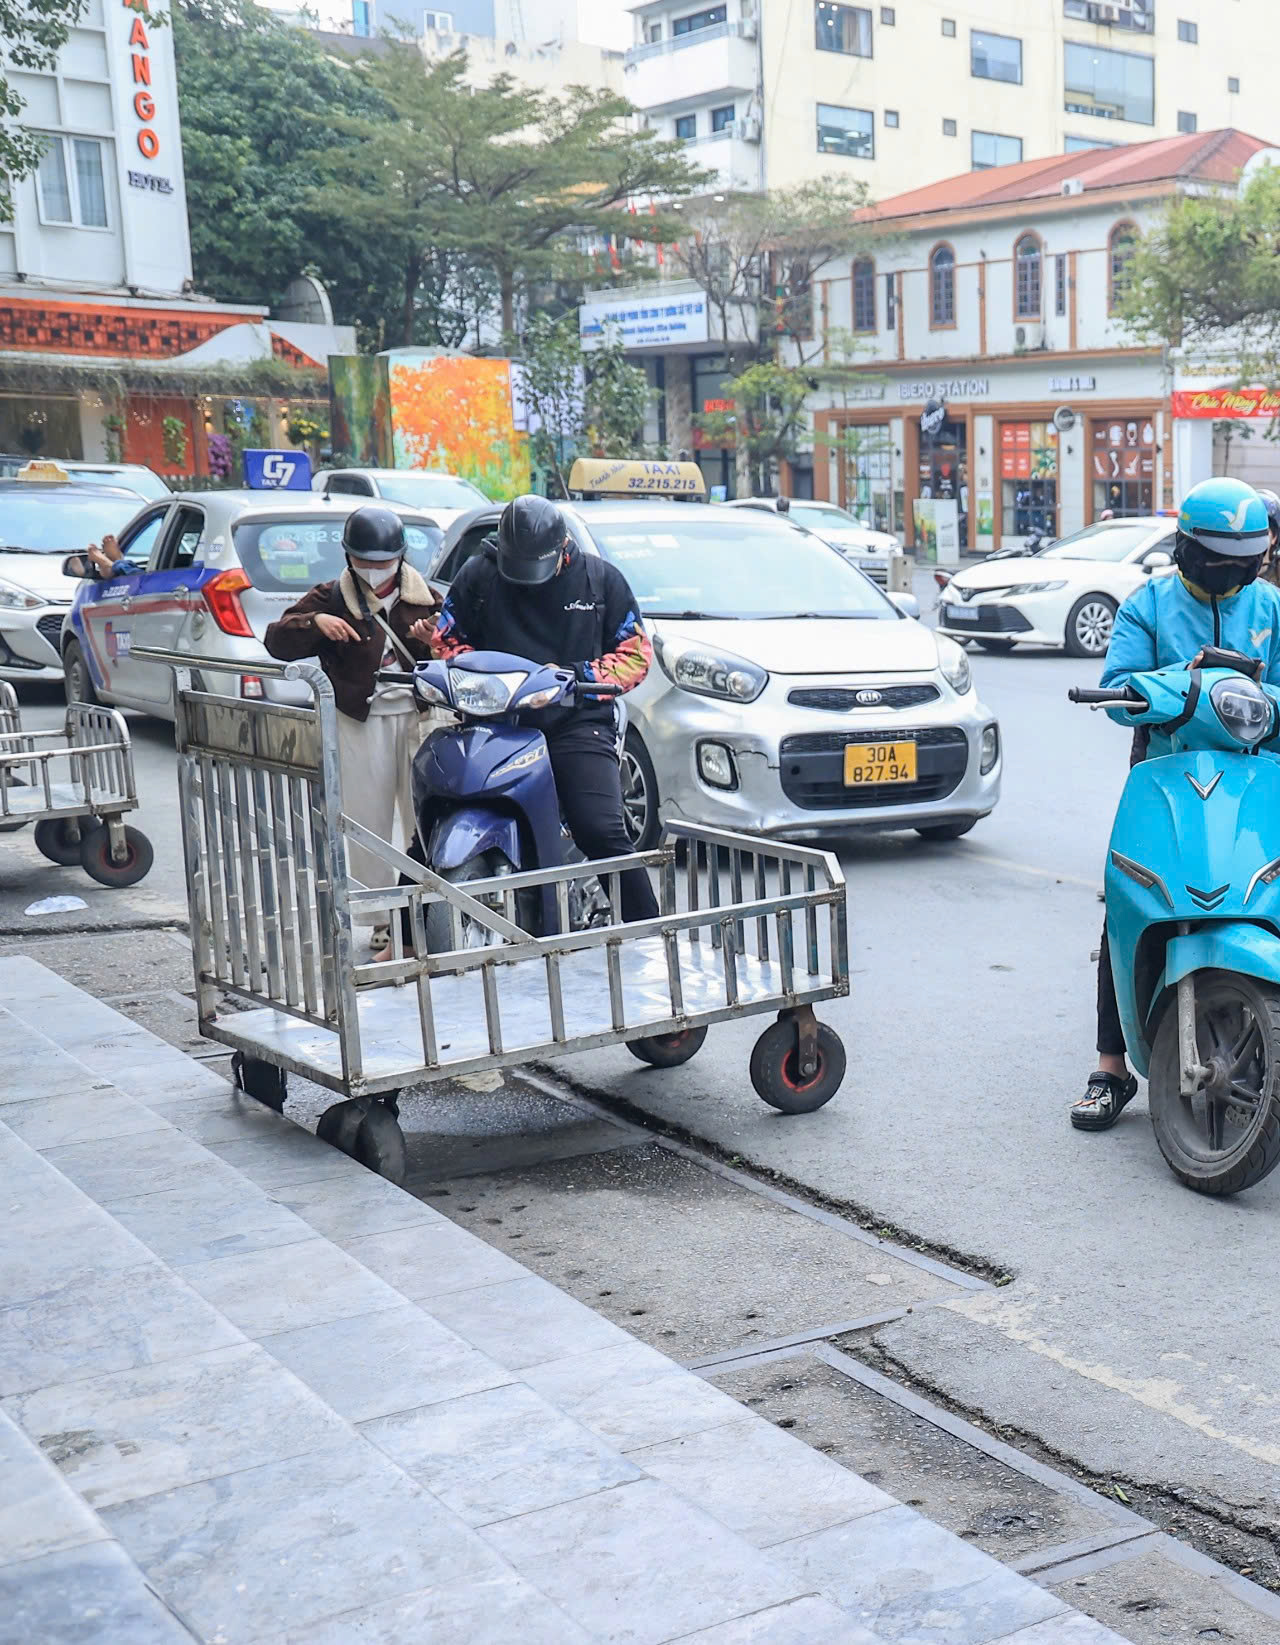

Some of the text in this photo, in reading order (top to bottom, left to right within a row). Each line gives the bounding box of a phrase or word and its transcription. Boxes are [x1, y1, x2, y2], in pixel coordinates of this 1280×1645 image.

[122, 0, 160, 160] ANGO
[938, 379, 990, 398] STATION
[263, 454, 296, 487] G7
[642, 463, 681, 475] TAXI
[628, 478, 696, 490] 32.215.215
[859, 692, 880, 702] KIA
[867, 746, 896, 763] 30A
[853, 764, 909, 783] 827.94
